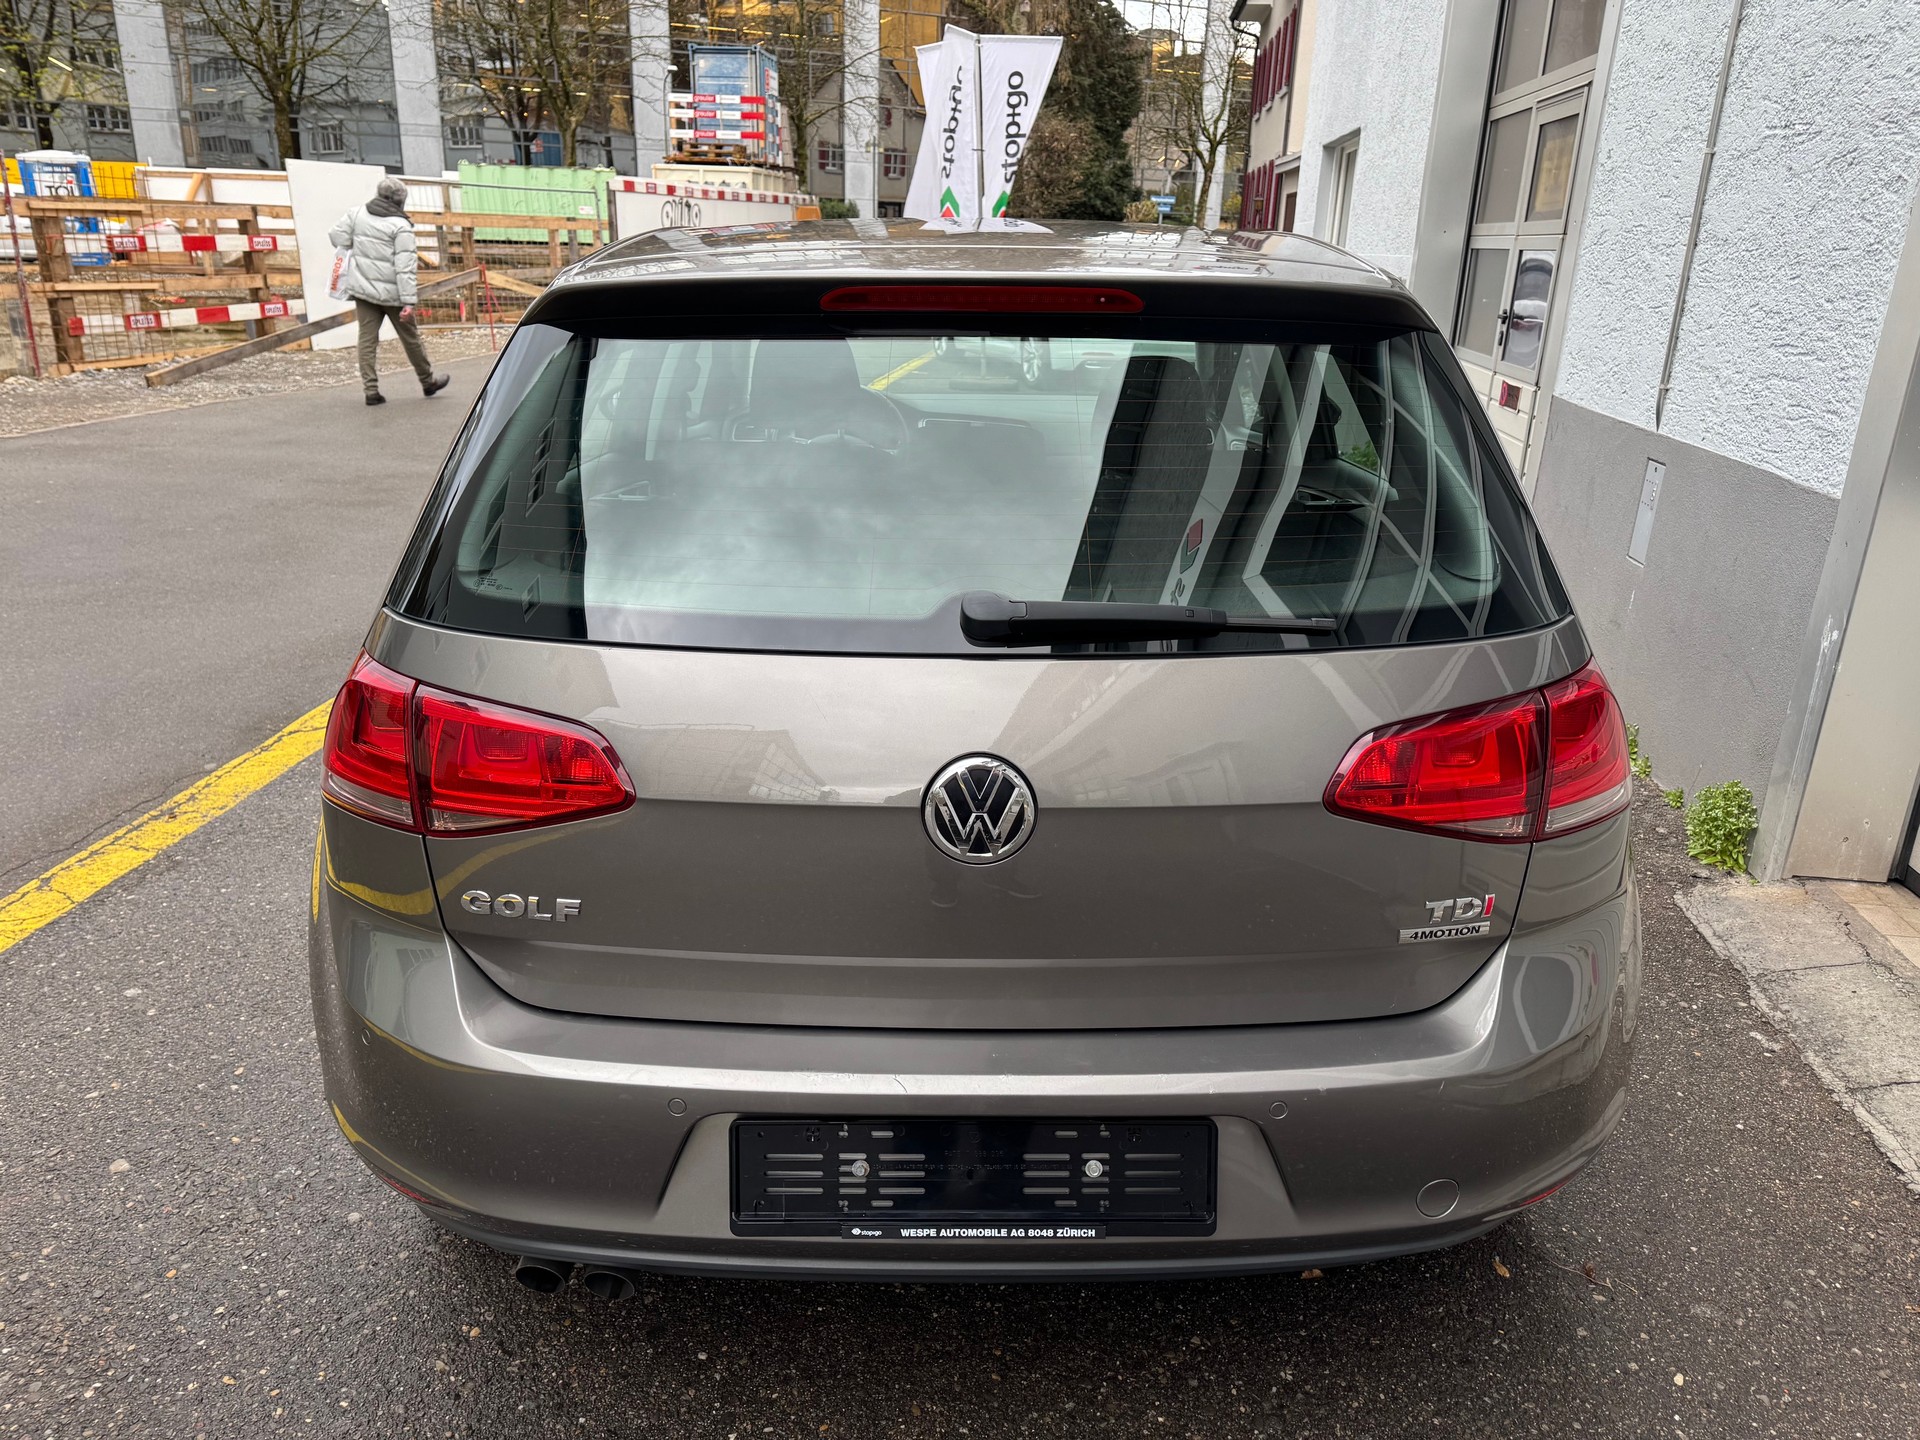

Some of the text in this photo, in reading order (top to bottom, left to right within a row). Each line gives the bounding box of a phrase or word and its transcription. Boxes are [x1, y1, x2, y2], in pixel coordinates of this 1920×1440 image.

[1001, 70, 1029, 184] stop+go
[460, 890, 582, 922] GOLF
[1425, 893, 1495, 924] TDI
[1410, 925, 1481, 940] 4MOTION
[900, 1228, 937, 1237] WESPE
[939, 1228, 1008, 1237] AUTOMOBILE
[1010, 1228, 1026, 1237] AG
[1028, 1228, 1054, 1237] 8048
[1056, 1226, 1096, 1237] ZÜRICH
